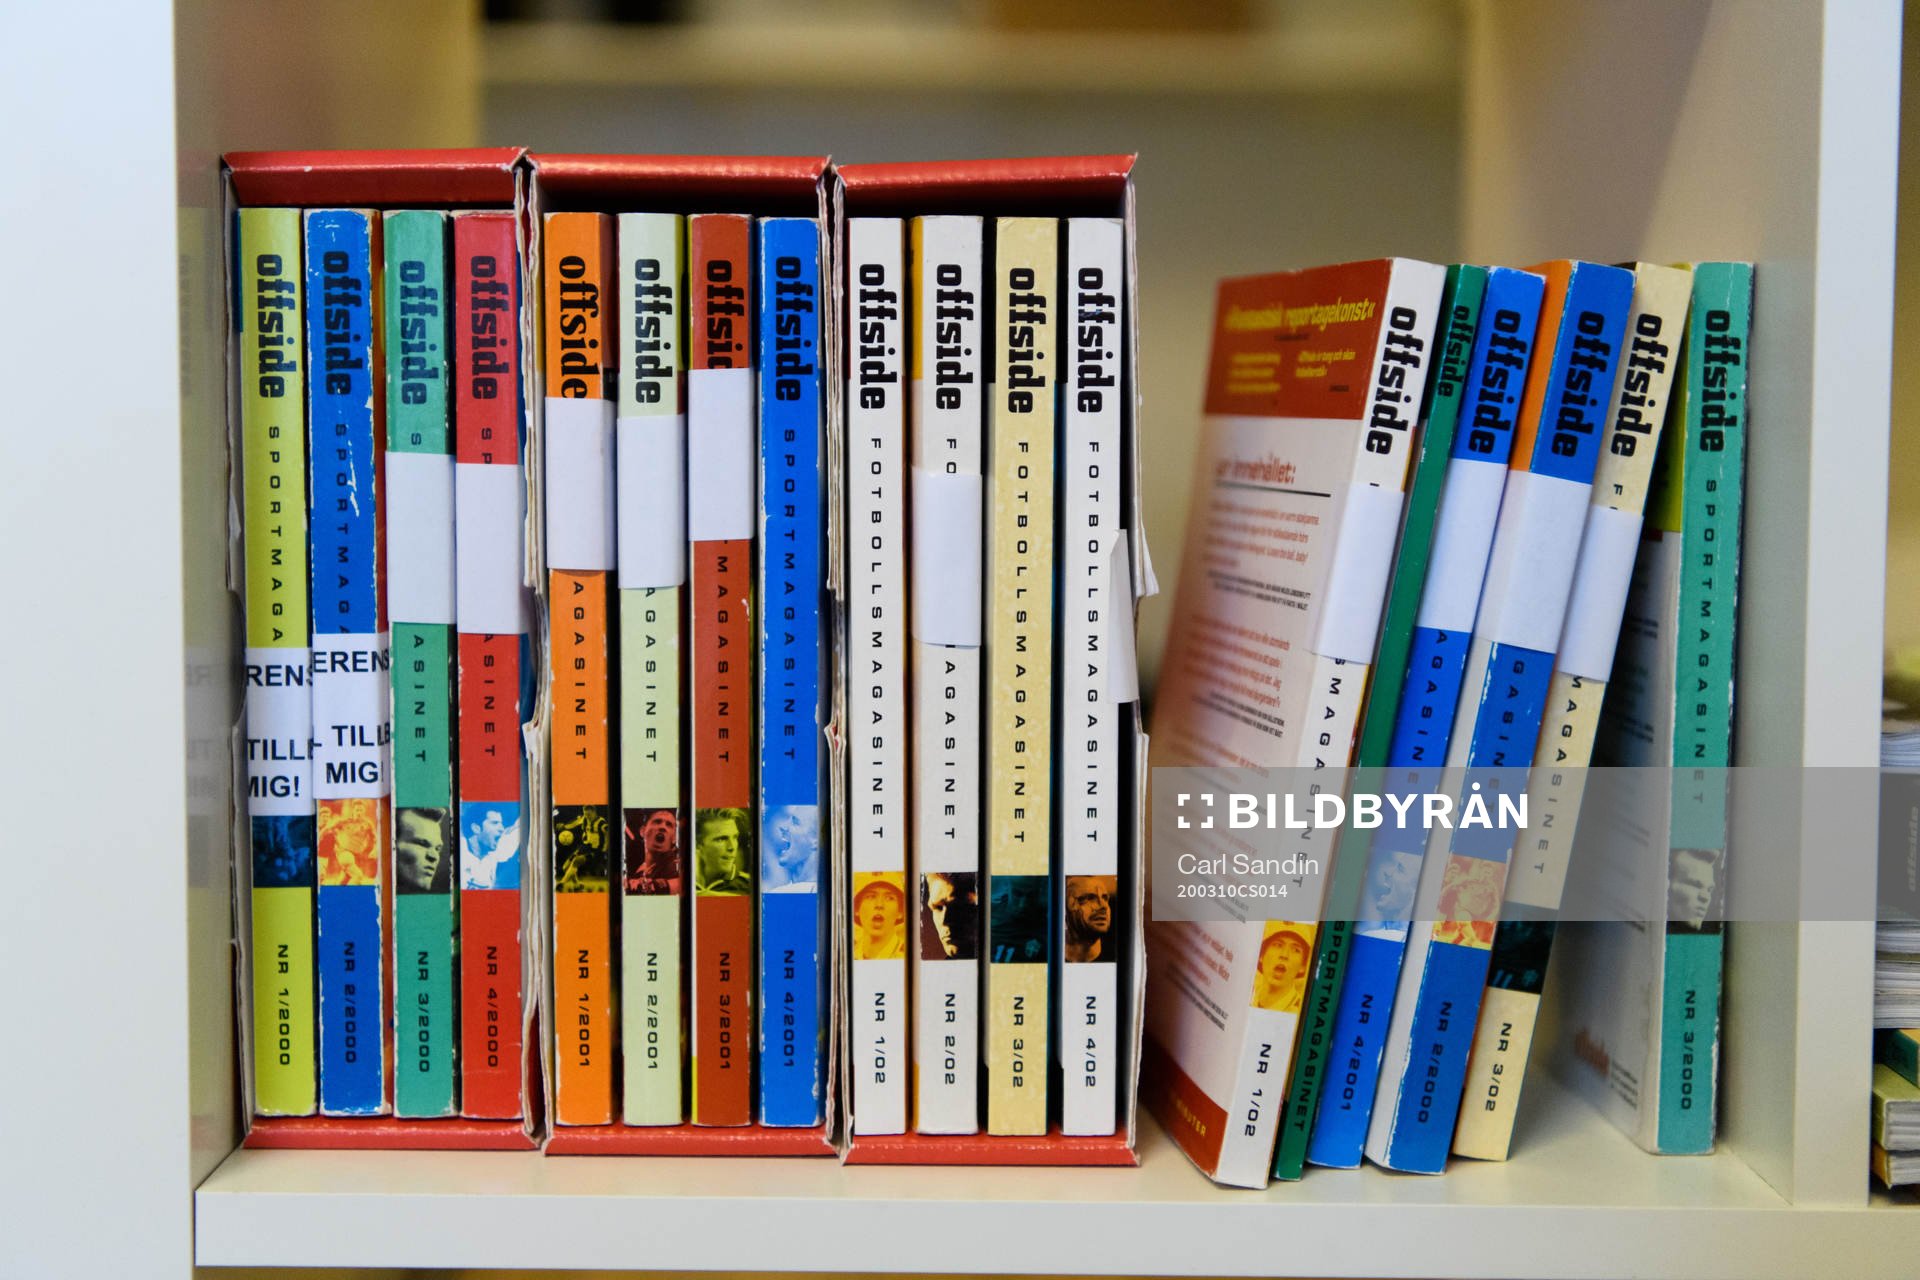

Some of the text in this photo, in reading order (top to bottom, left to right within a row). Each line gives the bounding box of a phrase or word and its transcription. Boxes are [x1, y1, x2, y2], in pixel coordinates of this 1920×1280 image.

[256, 254, 297, 398] offside
[323, 251, 363, 396] offside
[399, 260, 440, 405] offside
[470, 255, 510, 400] offside
[559, 255, 600, 398] offside
[634, 258, 673, 404] offside
[775, 256, 814, 401] offside
[859, 263, 898, 409] offside
[935, 264, 974, 410] offside
[1007, 267, 1047, 414] offside
[1077, 267, 1116, 413] offside
[1366, 305, 1424, 455] offside
[1438, 304, 1475, 398] offside
[1469, 309, 1528, 455] offside
[1552, 311, 1608, 458] offside
[1611, 313, 1668, 458] offside
[1700, 310, 1741, 453] offside
[268, 426, 283, 642] SPORTMAGA
[783, 429, 796, 759] SPORTMAGASINET
[573, 581, 587, 758] AGASINET
[645, 587, 657, 762] AGASINET
[717, 555, 729, 762] MAGASINET
[871, 438, 883, 838] FOTBOLLSMAGASINET
[1014, 442, 1029, 842] FOTBOLLSMAGASINET
[1086, 441, 1100, 841] FOTBOLLSMAGASINET
[1692, 479, 1717, 804] SPORTMAGASINET
[277, 944, 290, 1066] NR 1/2000
[343, 941, 357, 1064] NR 2/2000
[417, 951, 430, 1073] NR 3/2000
[486, 946, 499, 1068] NR 4/2000
[578, 949, 590, 1066] NR 1/2001
[647, 952, 658, 1069] NR 2/2001
[719, 952, 731, 1069] NR 3/2001
[783, 949, 795, 1067] NR 4/2001
[874, 992, 886, 1084] NR 1/02
[944, 993, 956, 1085] NR 2/02
[1012, 996, 1024, 1088] NR 3/02
[1085, 996, 1097, 1087] NR 4/02
[1294, 920, 1345, 1132] SPORTMAGASINET
[1341, 994, 1374, 1111] NR 4/2001
[1418, 1001, 1452, 1124] NR 2/2000
[1485, 1022, 1512, 1113] NR 3/02
[1681, 989, 1696, 1111] NR 3/2000
[1244, 1043, 1272, 1138] NR 1/02
